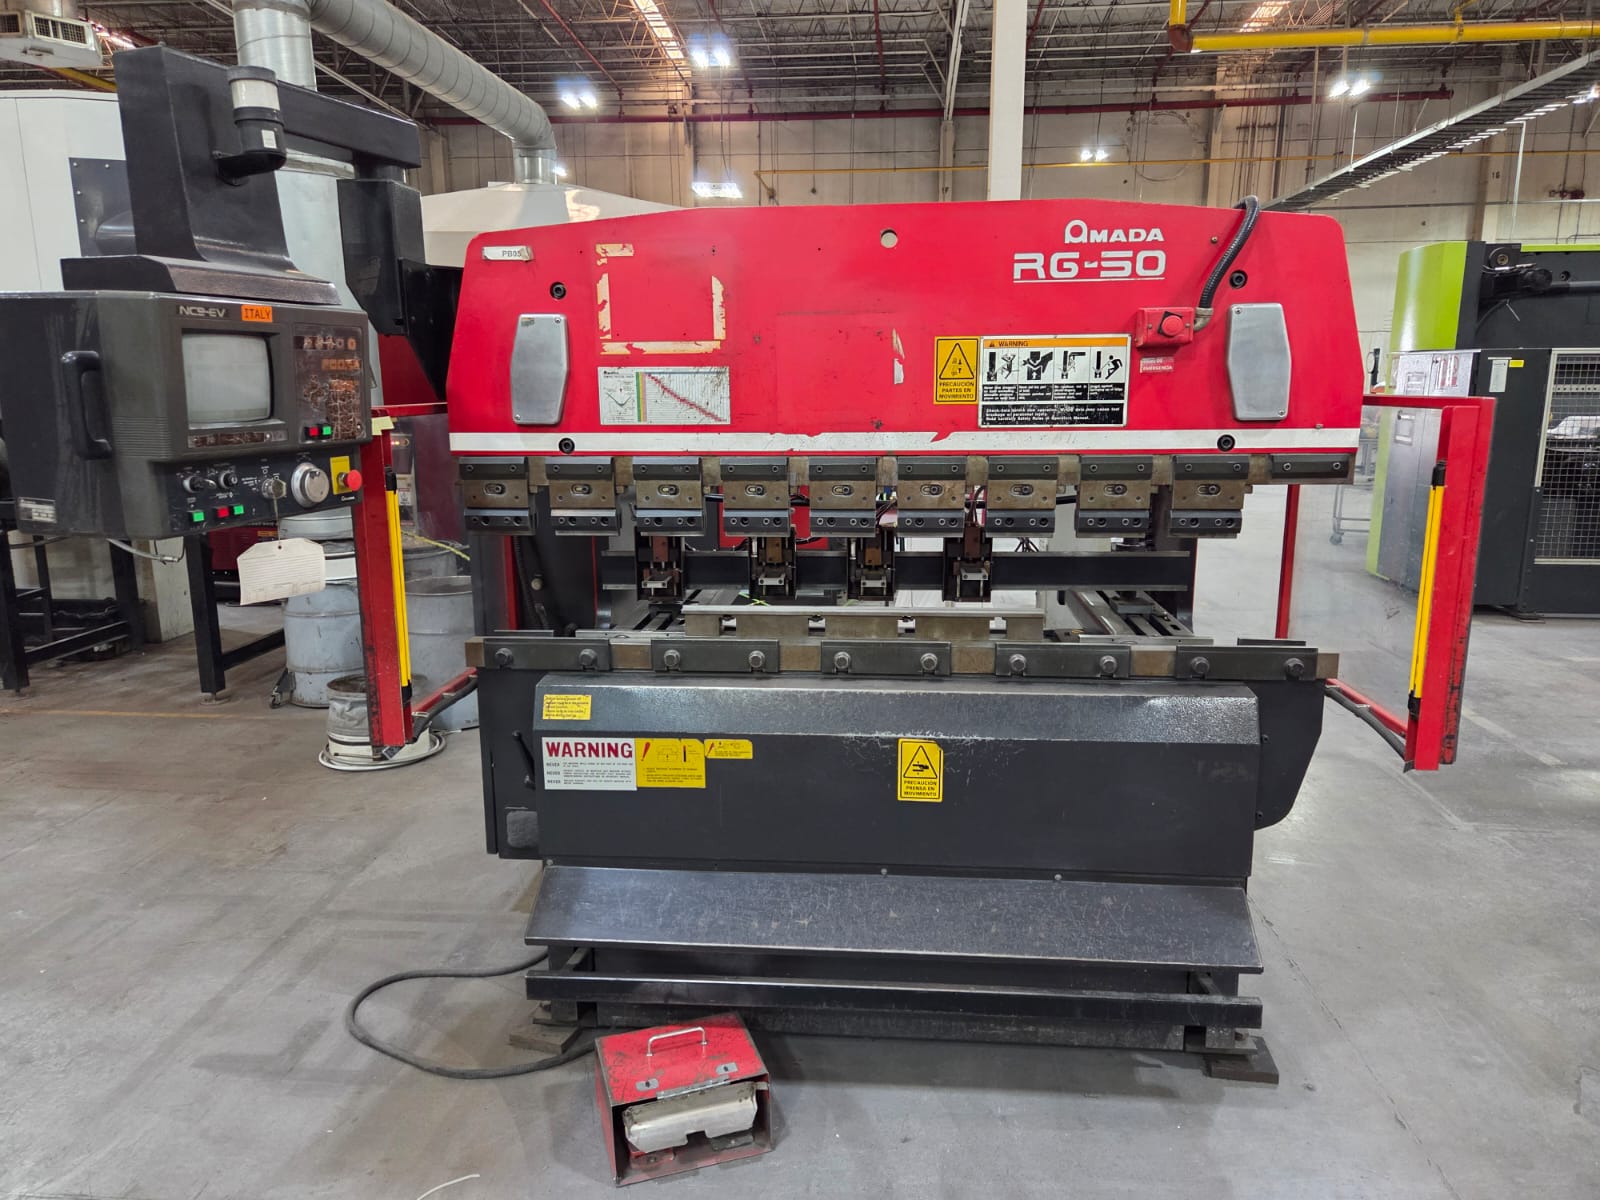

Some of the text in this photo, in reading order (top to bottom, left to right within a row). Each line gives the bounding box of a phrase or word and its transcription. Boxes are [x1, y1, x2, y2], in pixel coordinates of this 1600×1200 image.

[1064, 219, 1165, 244] AMADA
[1013, 250, 1166, 279] RG-50
[244, 308, 271, 320] ITALY
[998, 339, 1029, 347] WARNING
[546, 742, 633, 758] WARNING
